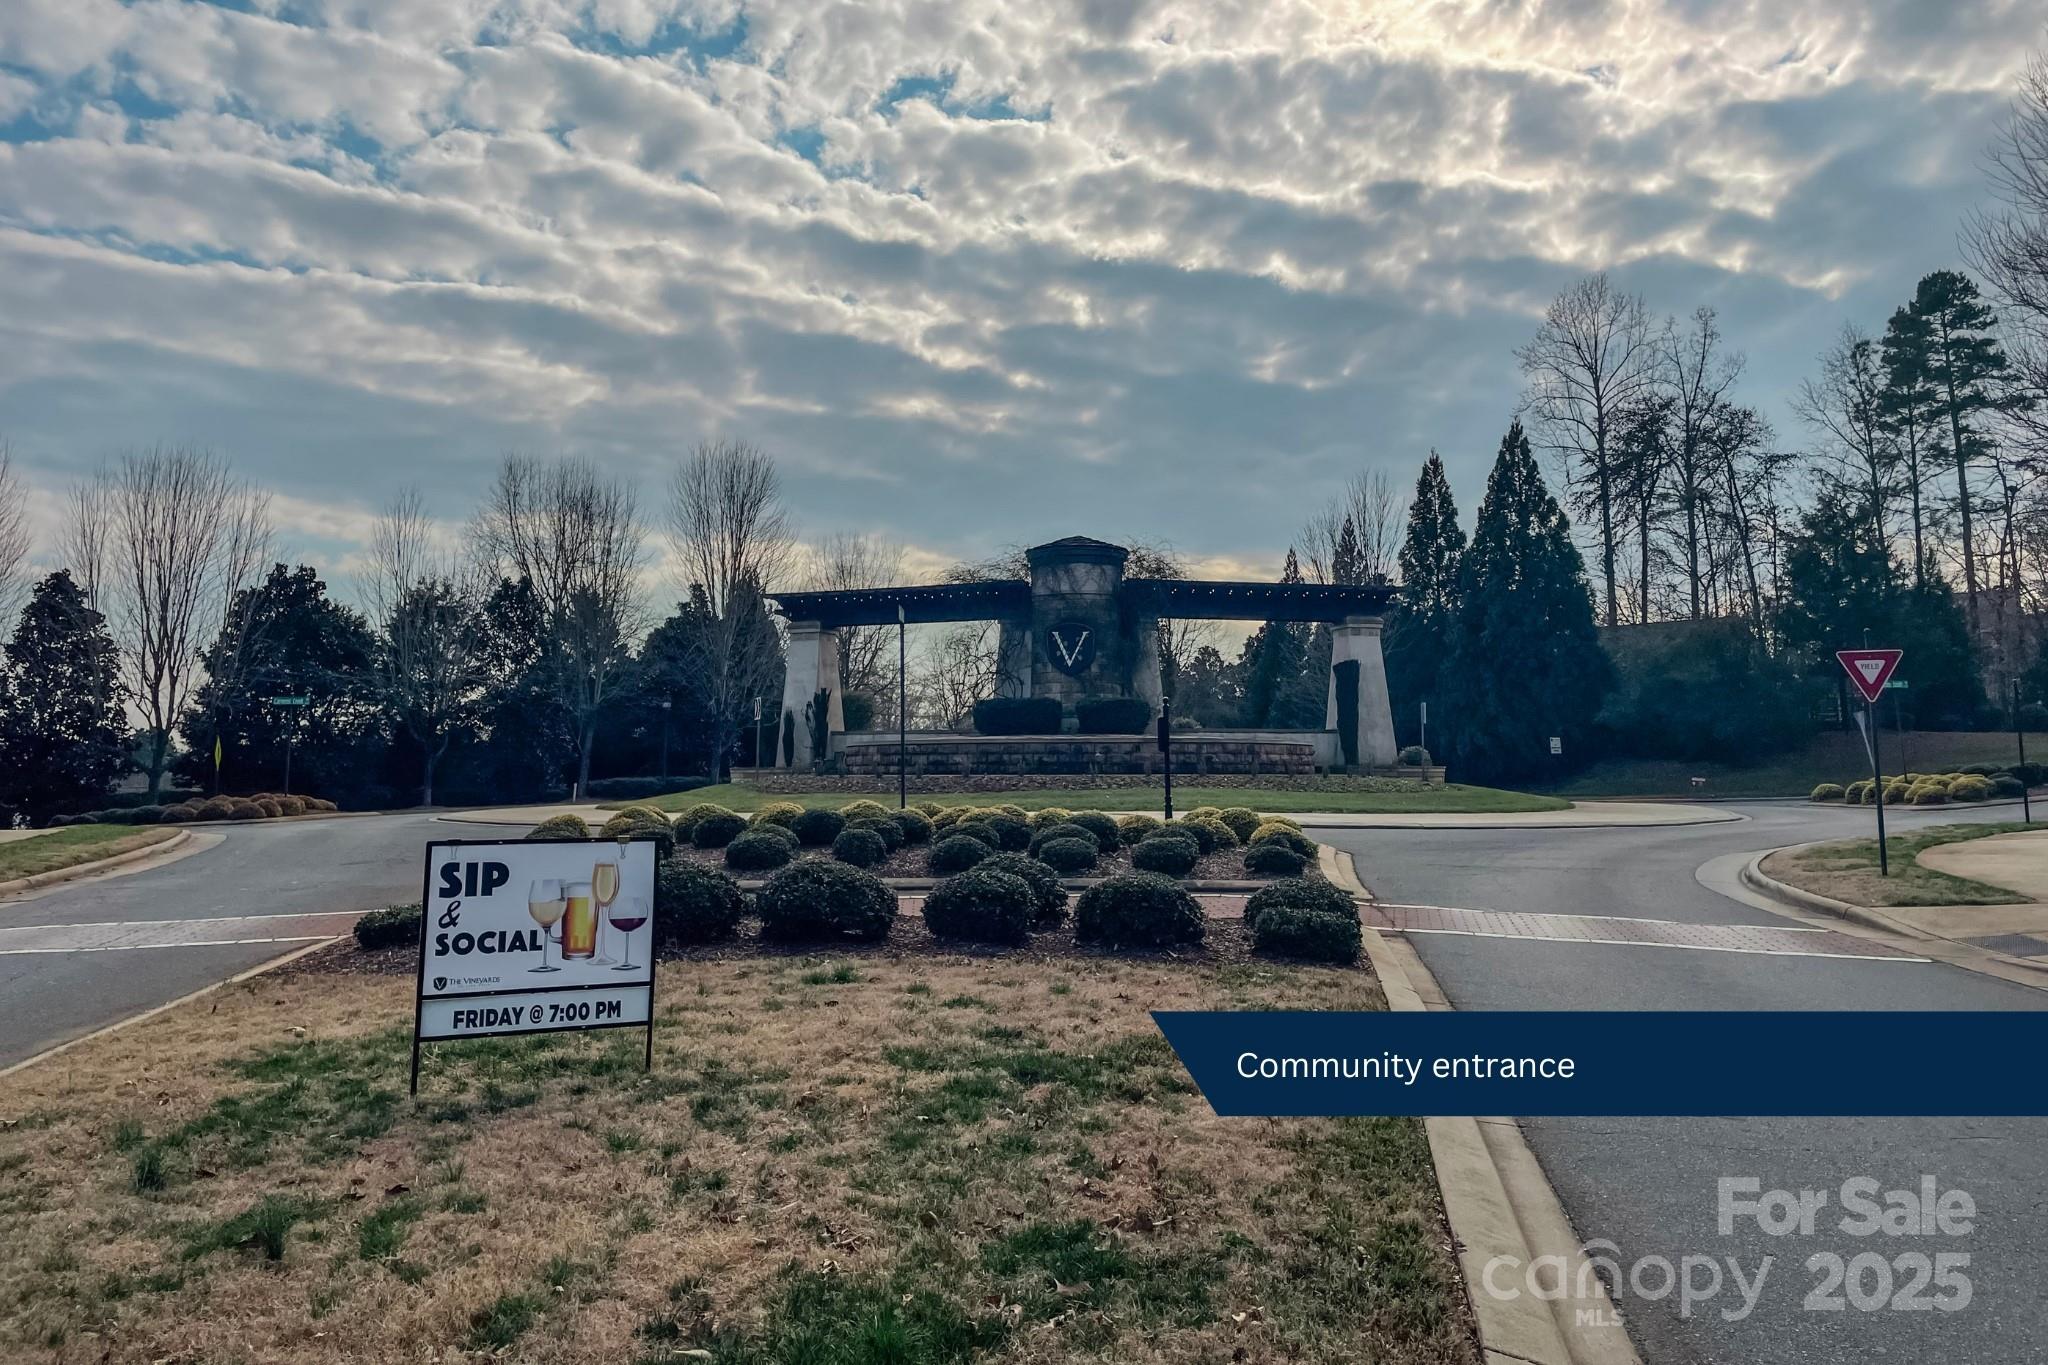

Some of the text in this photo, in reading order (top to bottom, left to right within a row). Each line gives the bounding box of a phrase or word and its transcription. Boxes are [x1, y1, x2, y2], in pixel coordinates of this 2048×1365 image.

[1052, 631, 1090, 668] V
[438, 861, 510, 898] SIP
[438, 900, 461, 929] &
[434, 929, 543, 957] SOCIAL
[452, 1000, 622, 1029] FRIDAY @ 7:00 PM
